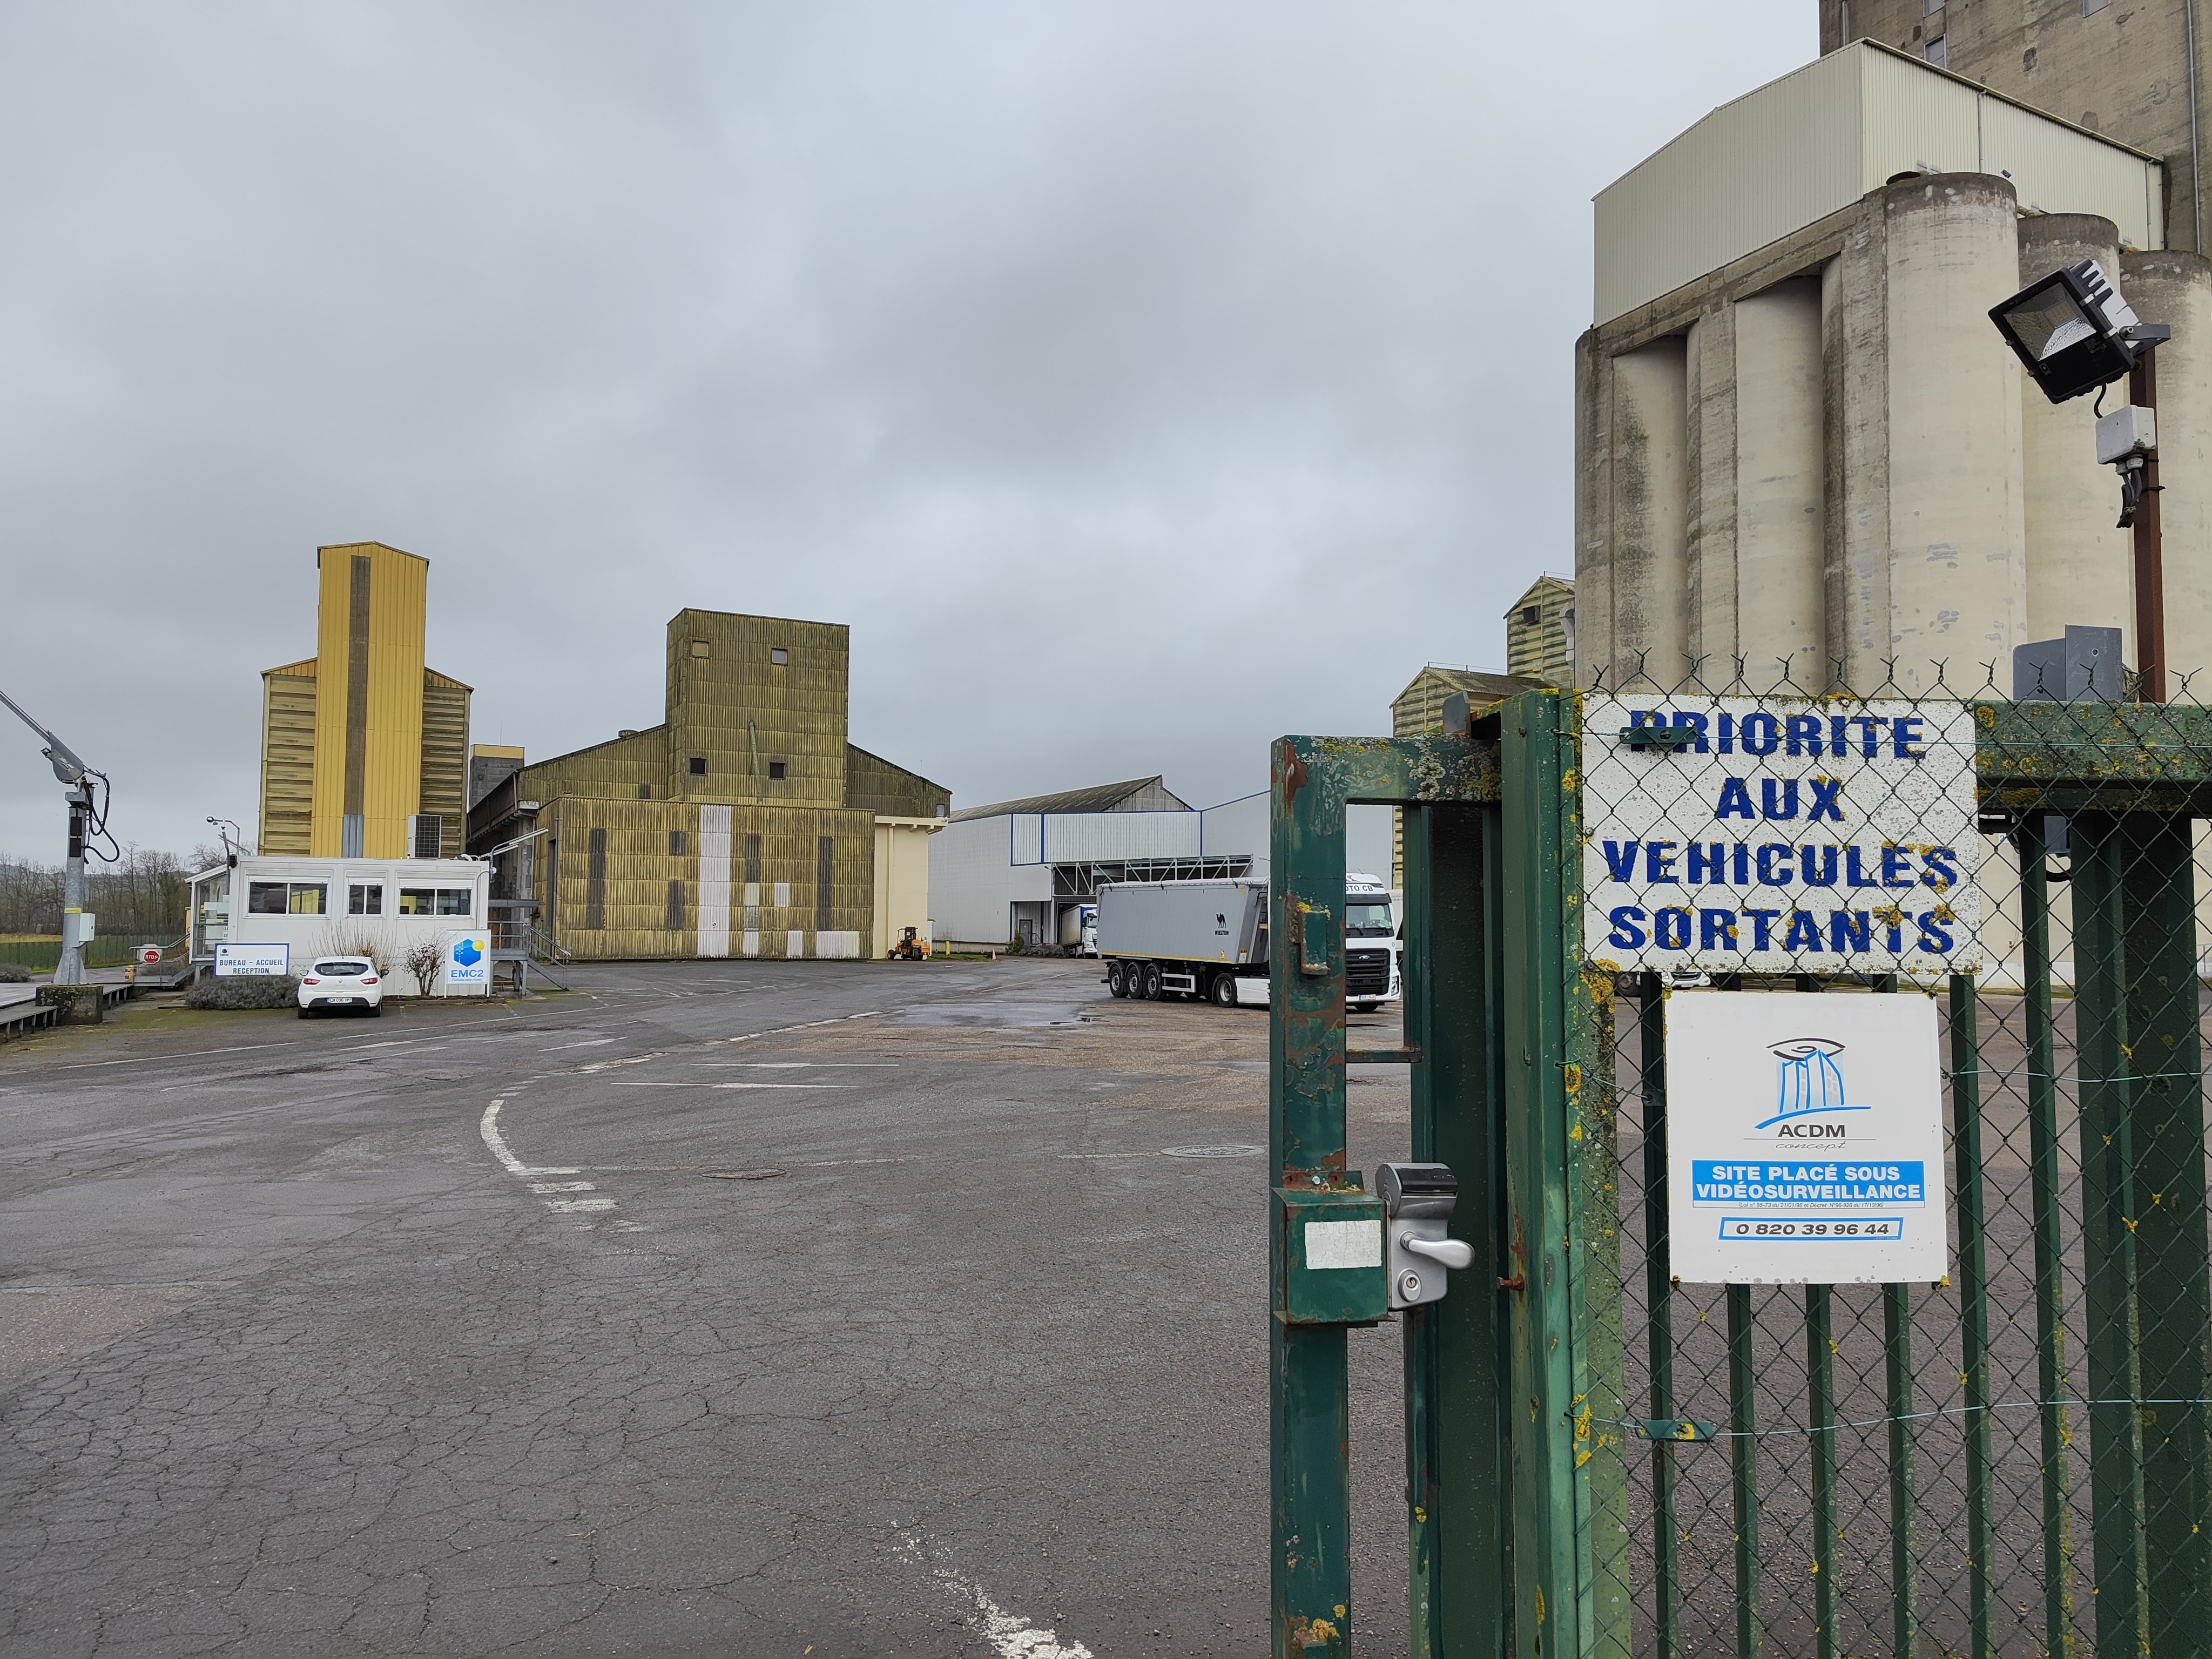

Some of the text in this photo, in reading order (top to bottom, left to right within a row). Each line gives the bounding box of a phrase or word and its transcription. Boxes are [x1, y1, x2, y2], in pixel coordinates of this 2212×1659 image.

[1630, 710, 1926, 759] PRIORITE
[1716, 777, 1846, 821] AUX
[1602, 840, 1958, 888] VEHICULES
[1608, 905, 1955, 955] SORTANTS
[451, 969, 484, 977] EMC2
[1777, 1124, 1845, 1137] ACDM
[1776, 1141, 1846, 1152] concept
[1712, 1163, 1900, 1181] SITE PLACÉ SOUS
[1696, 1181, 1921, 1199] VIDÉOSURVEILLANCE
[1736, 1224, 1889, 1235] 0 820 39 96 44
